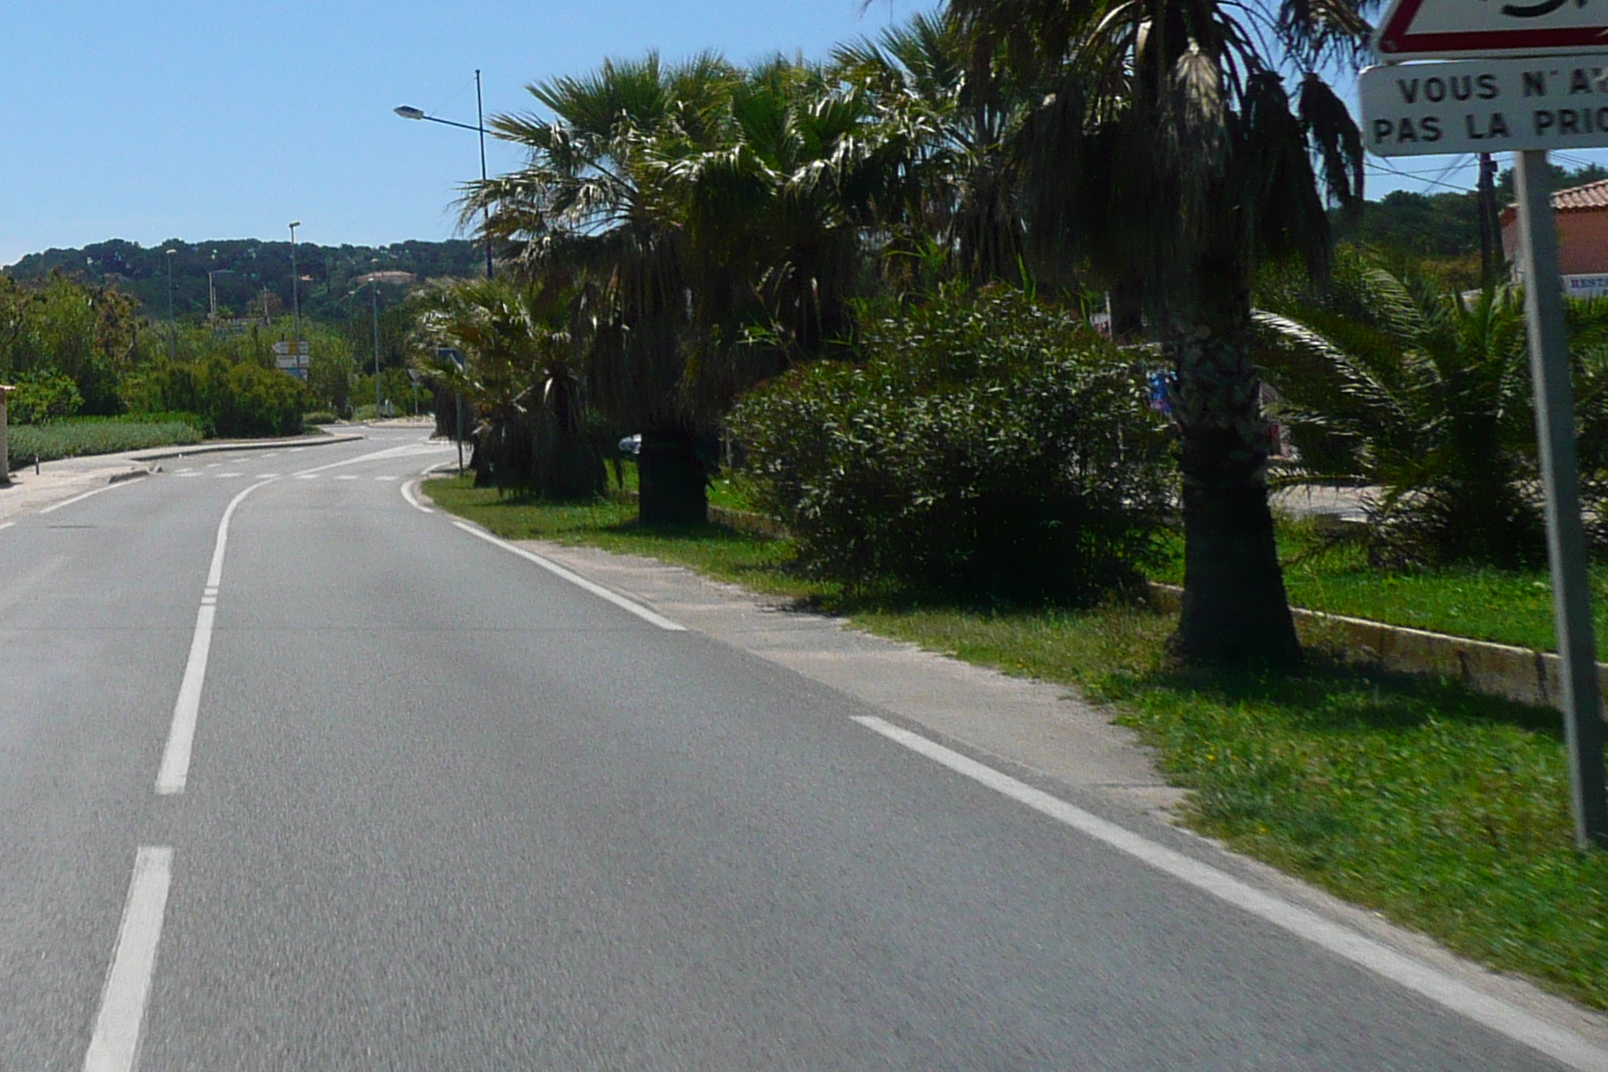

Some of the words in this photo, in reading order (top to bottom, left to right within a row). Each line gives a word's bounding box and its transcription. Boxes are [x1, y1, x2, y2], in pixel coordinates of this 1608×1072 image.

[1396, 73, 1498, 104] VOUS
[1373, 115, 1443, 145] PAS
[1465, 112, 1509, 140] LA
[1570, 278, 1608, 288] REST
